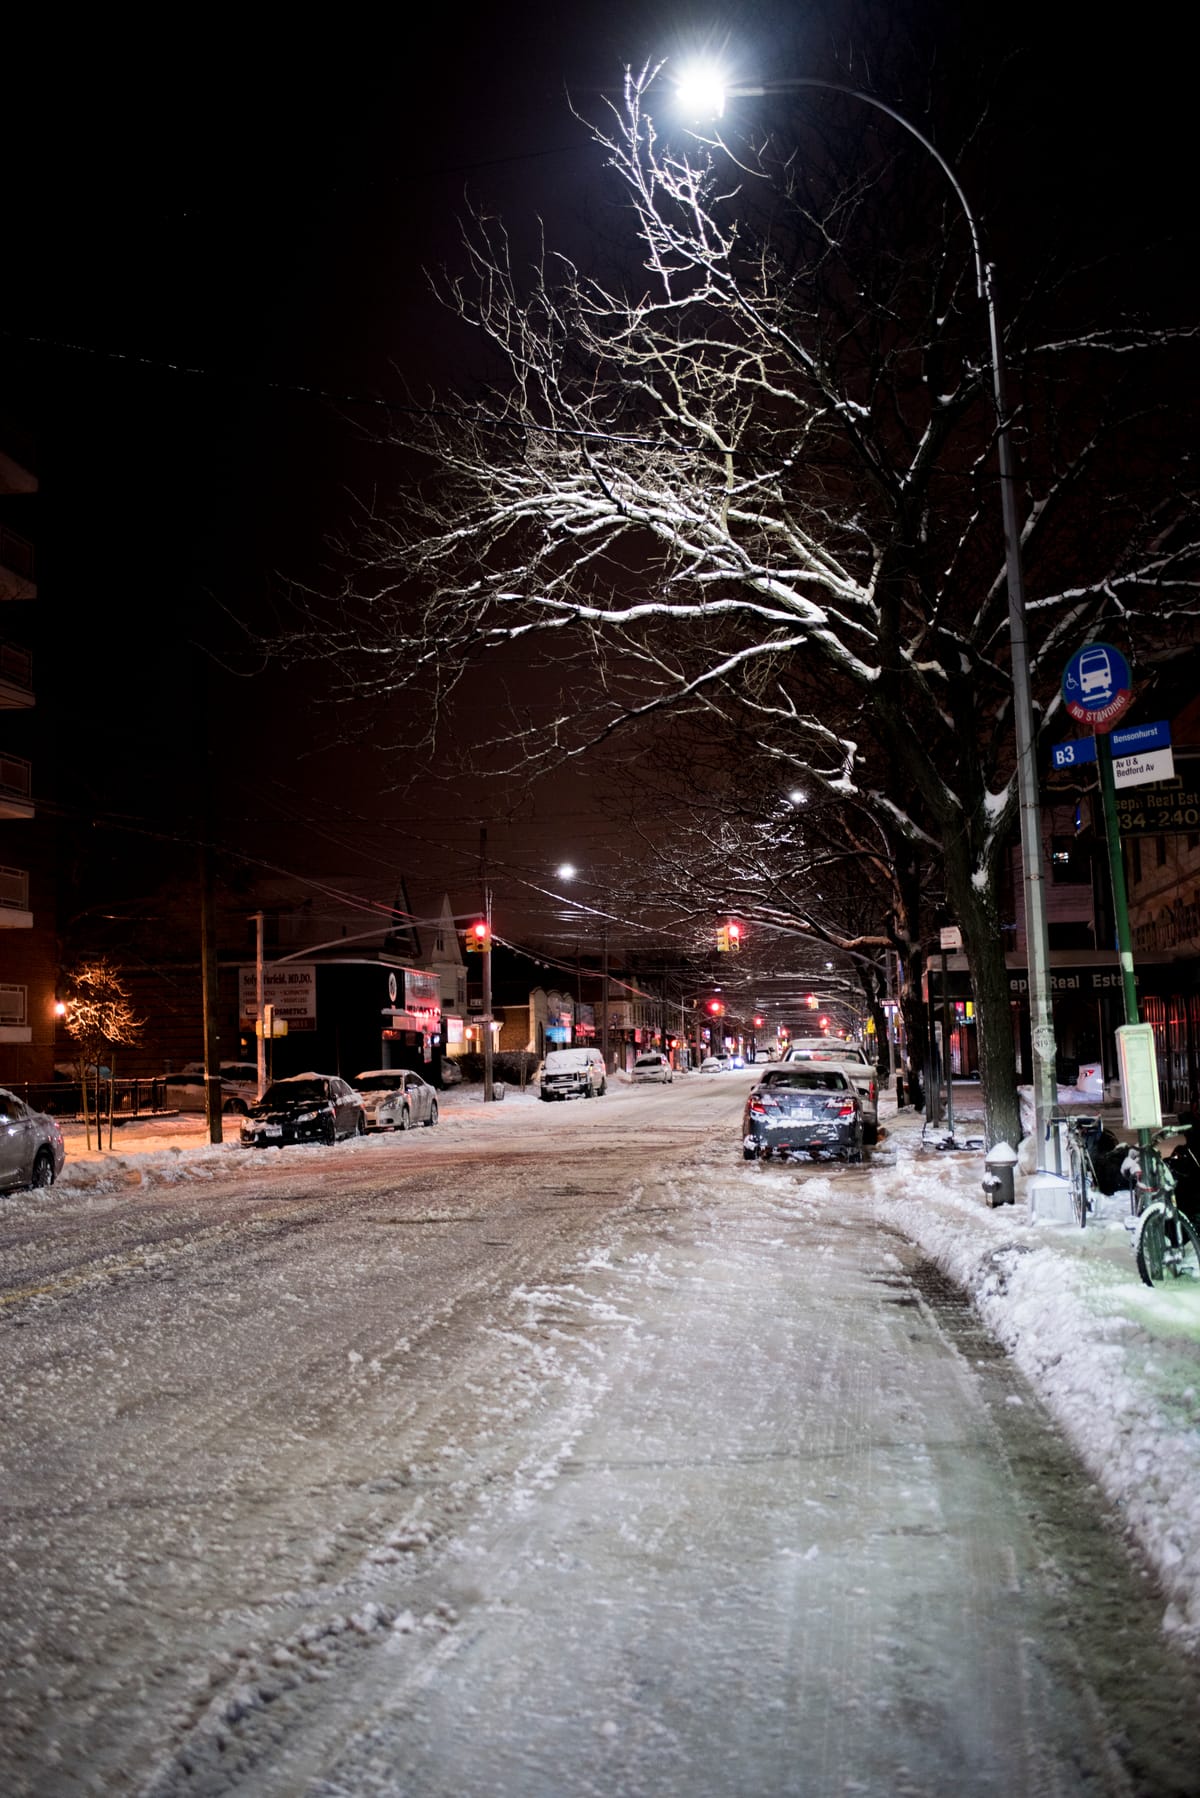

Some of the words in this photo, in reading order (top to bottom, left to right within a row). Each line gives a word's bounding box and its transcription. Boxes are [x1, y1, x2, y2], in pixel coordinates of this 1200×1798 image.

[1071, 706, 1084, 719] NO
[1086, 695, 1126, 722] STANDING
[1113, 727, 1158, 744] Bensonhurst
[1056, 745, 1075, 765] B3
[1116, 760, 1125, 768] Av
[1127, 759, 1132, 767] U
[1133, 758, 1139, 766] &
[1116, 765, 1144, 778] Bedford
[1146, 764, 1155, 772] Av
[1146, 792, 1175, 808] Real
[1117, 808, 1200, 830] 34-240
[1010, 979, 1029, 992] ep
[1050, 976, 1080, 989] Real
[1092, 974, 1140, 988] Estae
